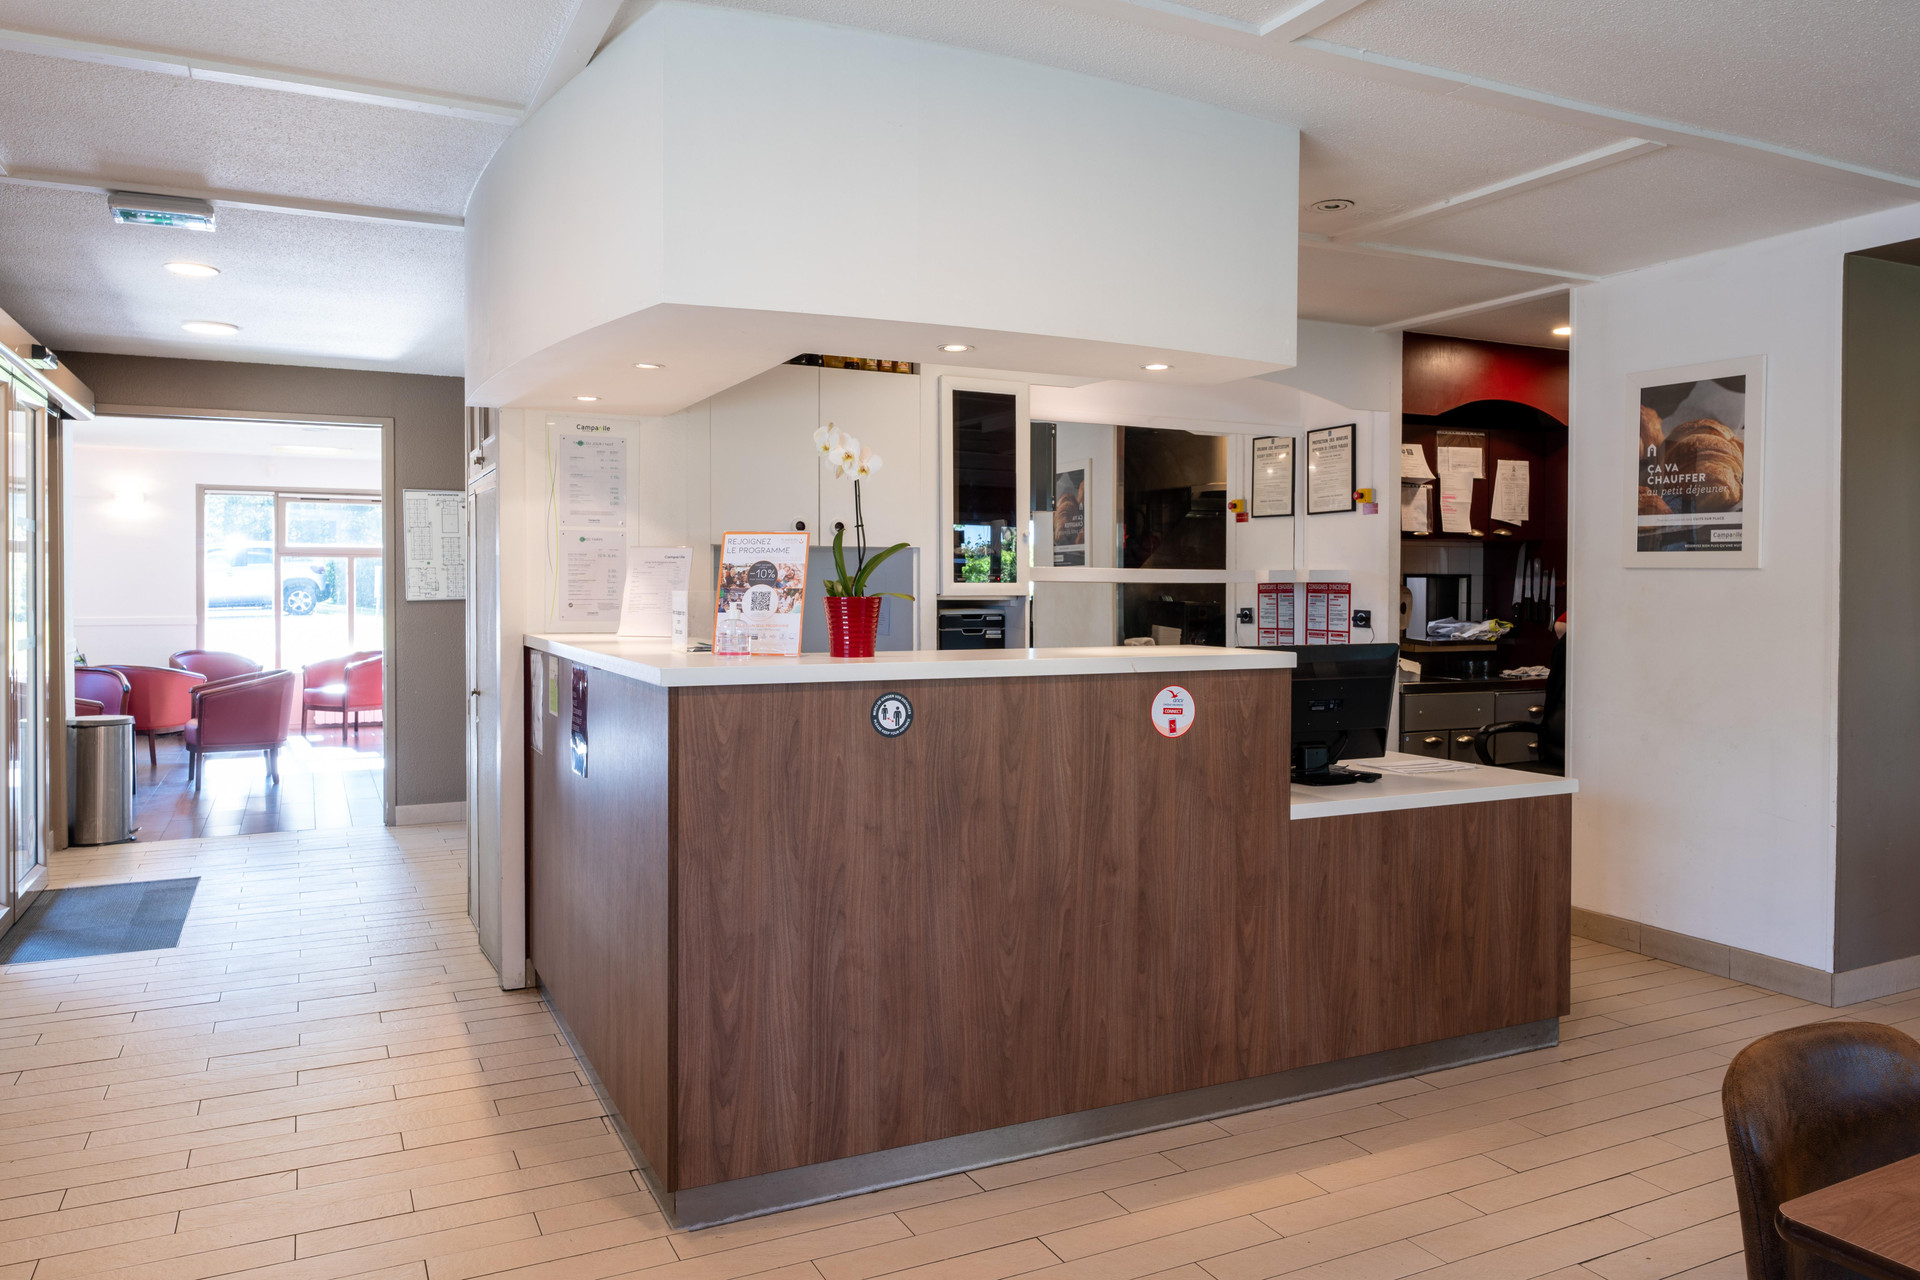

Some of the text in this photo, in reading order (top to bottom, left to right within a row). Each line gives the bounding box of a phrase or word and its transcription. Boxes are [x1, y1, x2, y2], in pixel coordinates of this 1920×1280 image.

[1647, 463, 1679, 476] ÇA VA
[1647, 473, 1706, 485] CHAUFFER
[1646, 484, 1729, 498] au petit déjeuner
[750, 569, 776, 579] -10%
